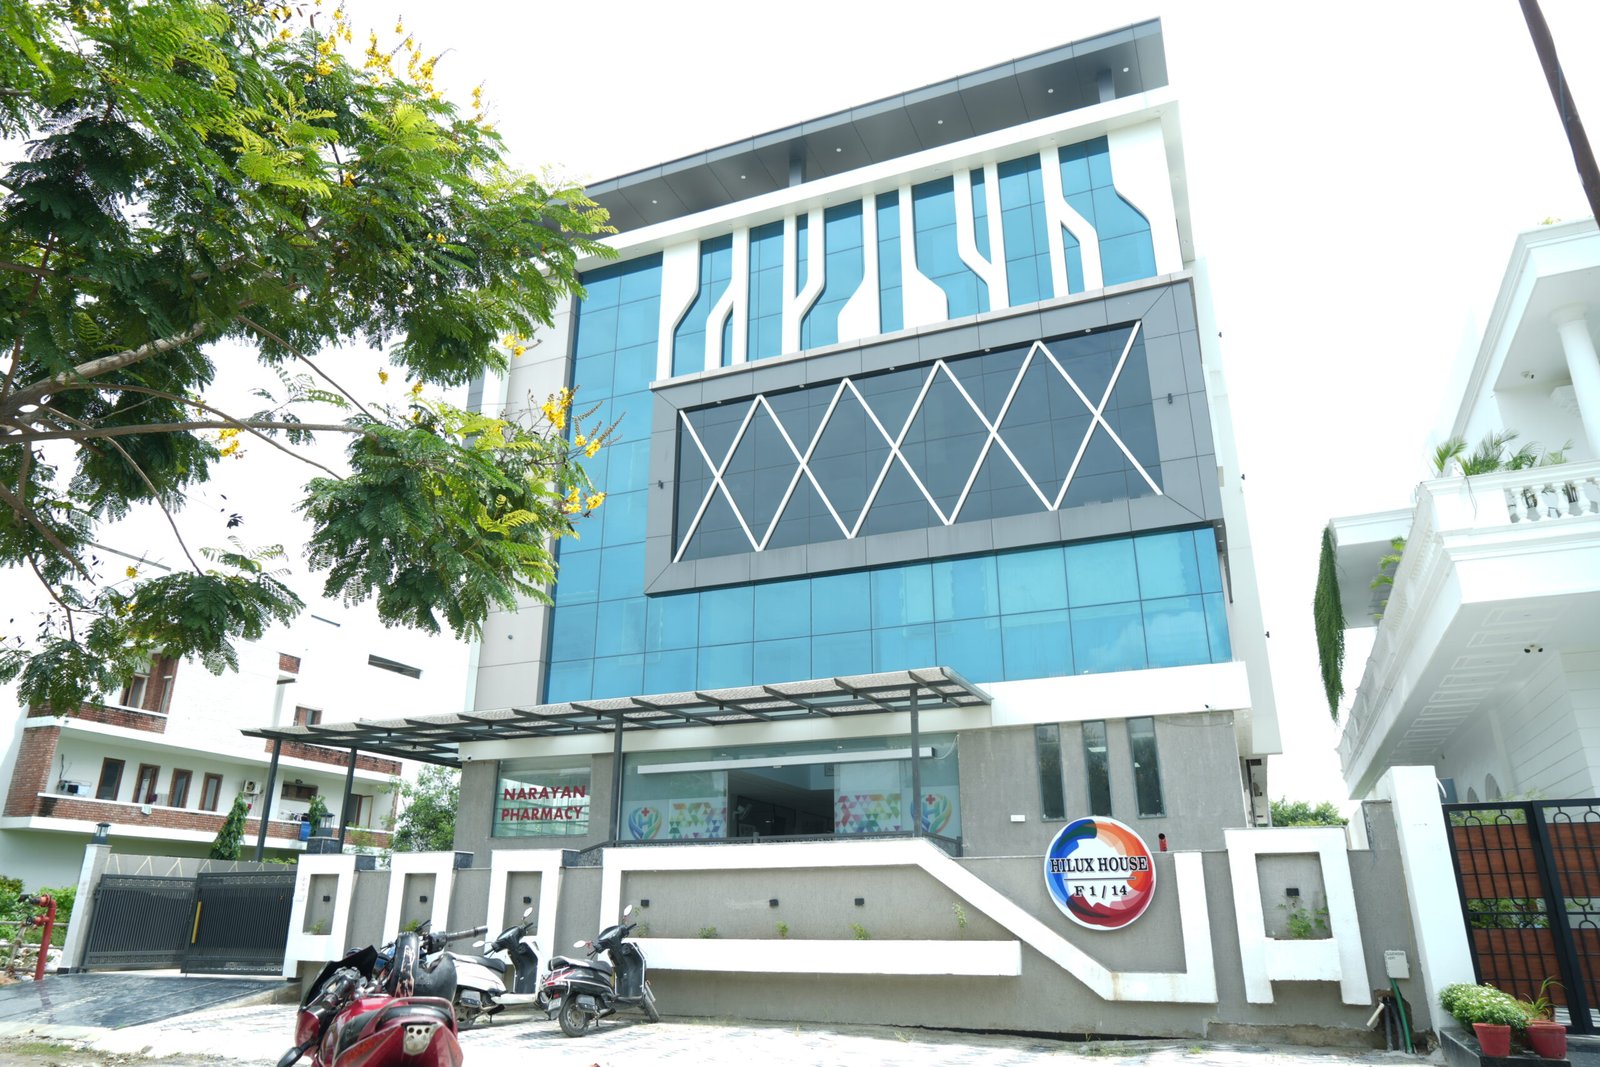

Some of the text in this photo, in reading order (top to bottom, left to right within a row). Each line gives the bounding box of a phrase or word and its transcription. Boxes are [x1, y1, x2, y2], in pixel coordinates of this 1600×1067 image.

[503, 784, 586, 801] NARAYAN
[501, 806, 583, 821] PHARMACY
[1050, 856, 1148, 873] HILUX HOUSE
